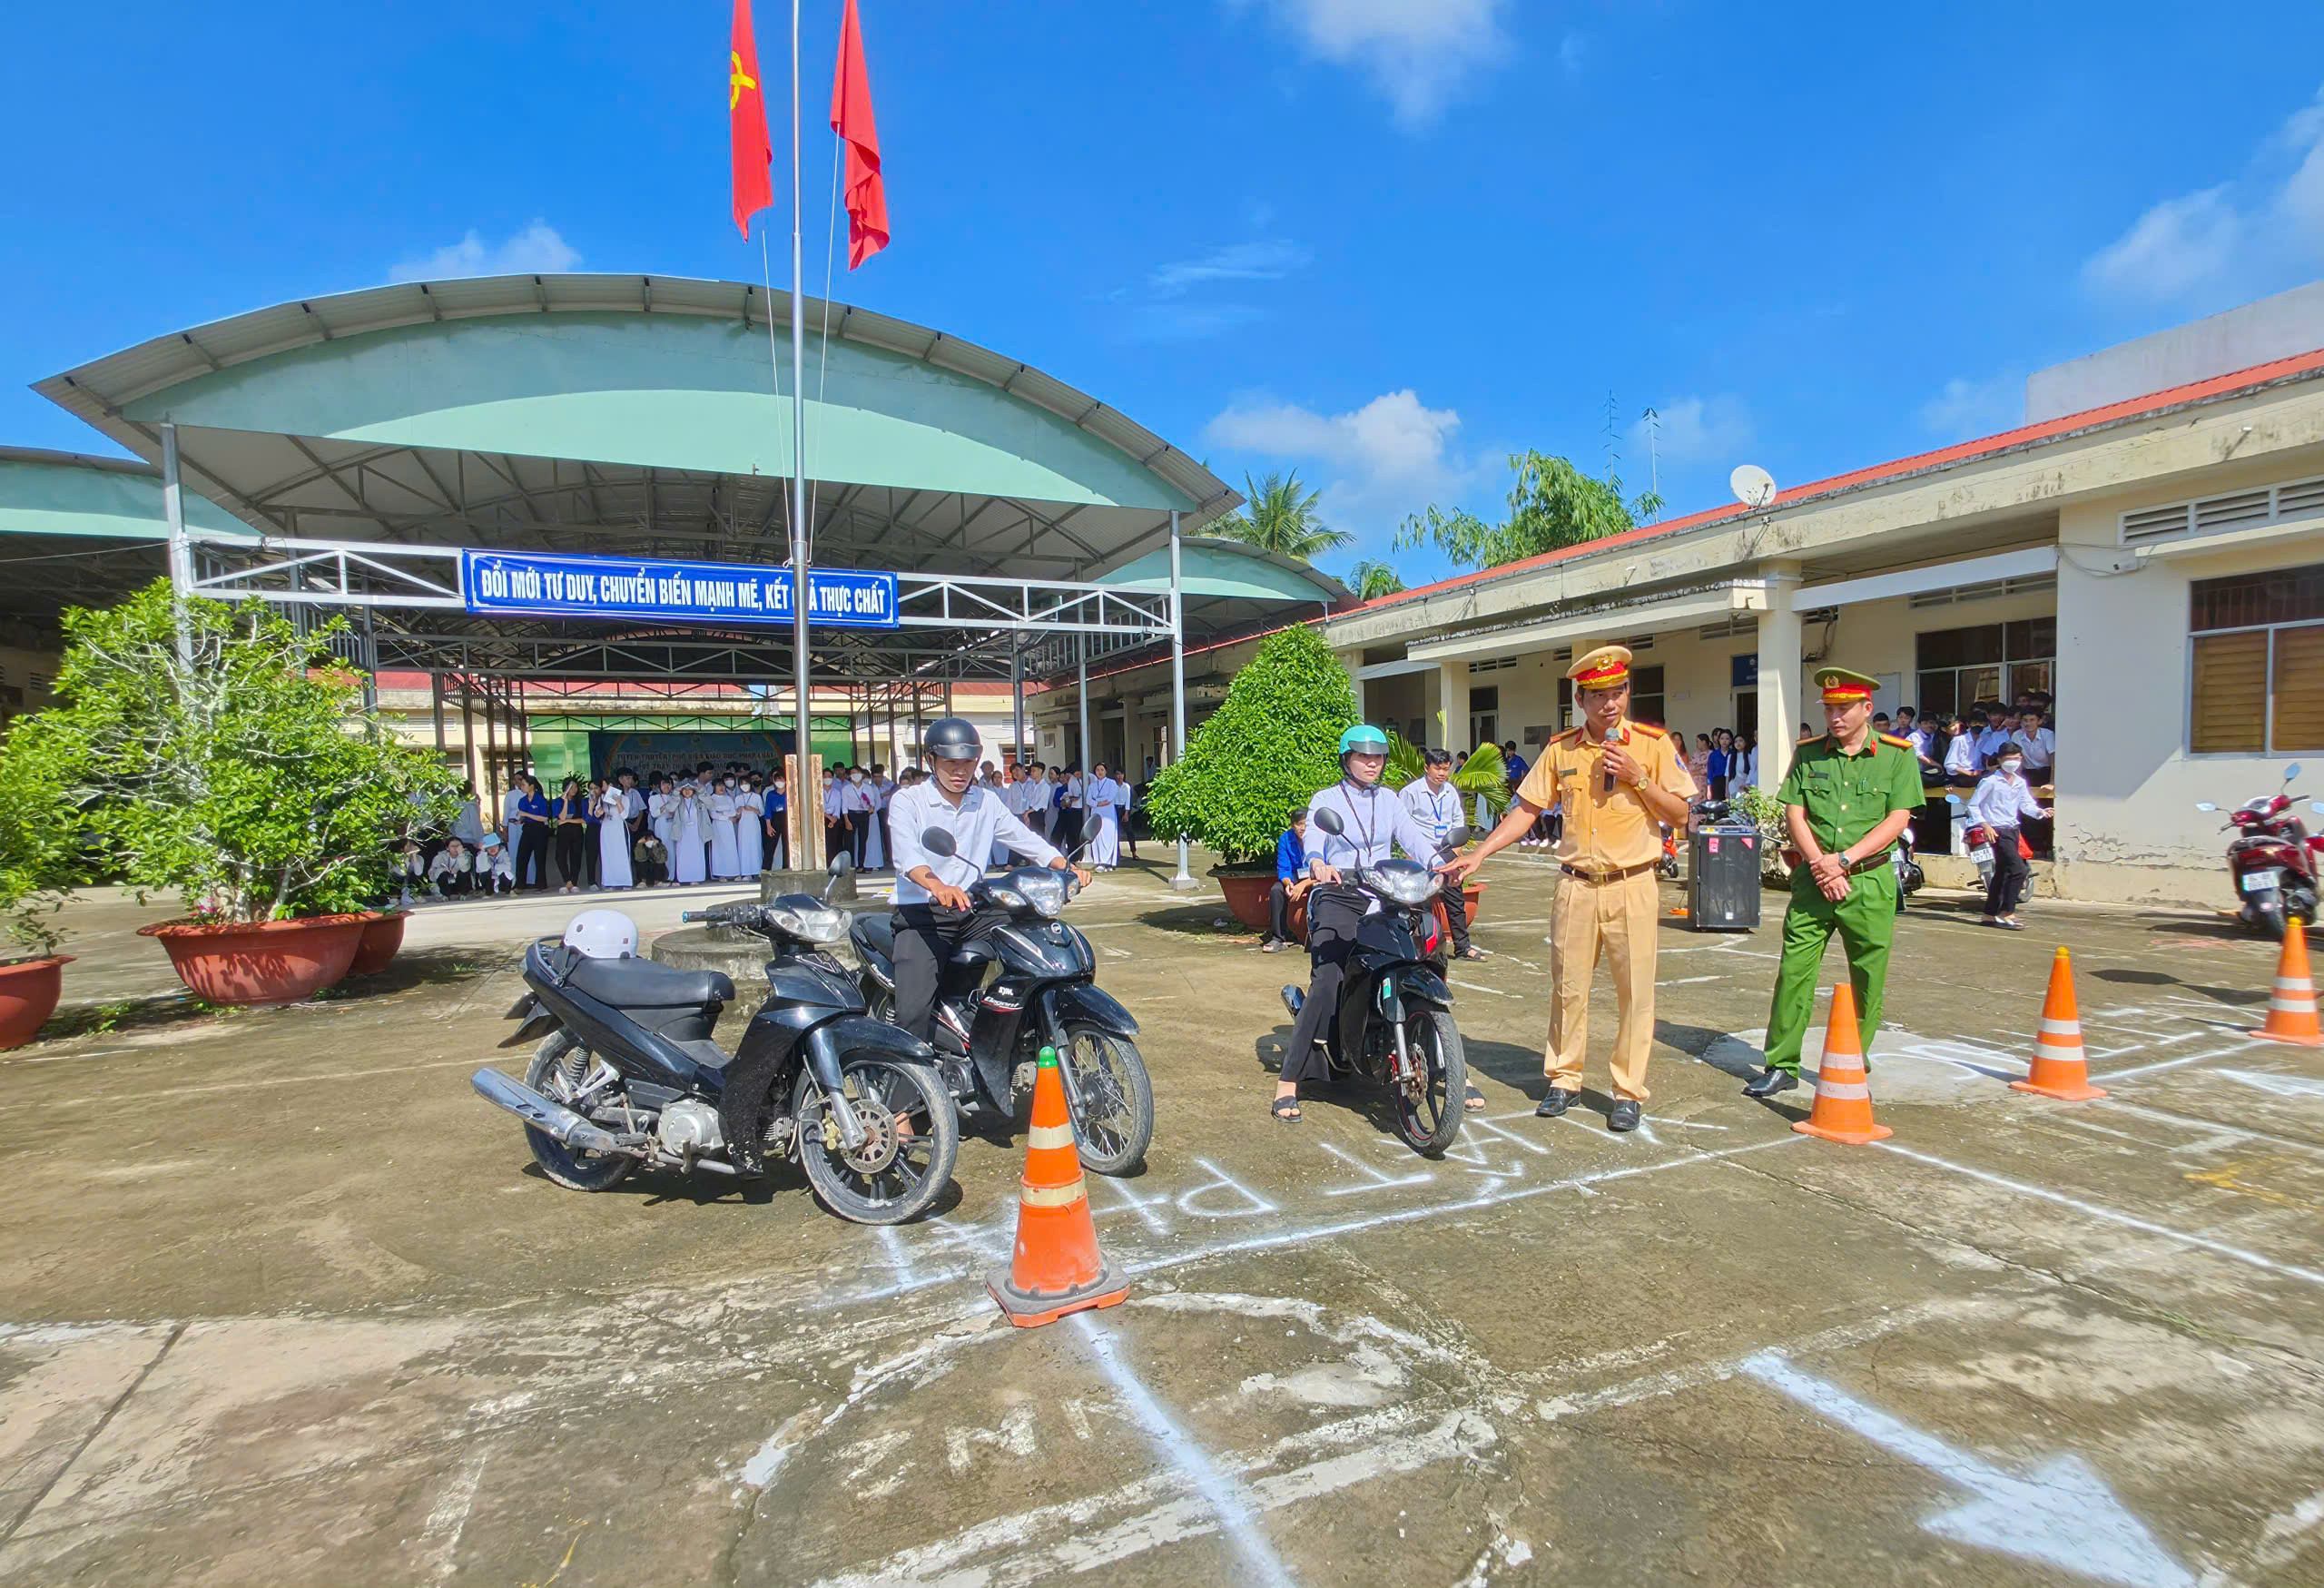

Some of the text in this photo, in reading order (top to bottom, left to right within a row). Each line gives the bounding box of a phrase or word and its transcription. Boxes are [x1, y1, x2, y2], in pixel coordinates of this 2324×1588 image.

[481, 560, 507, 597] ĐỔI
[512, 567, 541, 598] MỚI
[545, 571, 563, 600] TƯ
[566, 574, 597, 605] DUY,
[600, 567, 655, 604] CHUYỂN
[659, 571, 691, 606] BIẾN
[694, 581, 734, 612] MẠNH
[738, 578, 762, 611] MẼ,
[765, 577, 788, 609] KẾT
[821, 586, 851, 617] THỰC
[854, 581, 885, 614] CHẤT
[984, 996, 1019, 1008] Elegant
